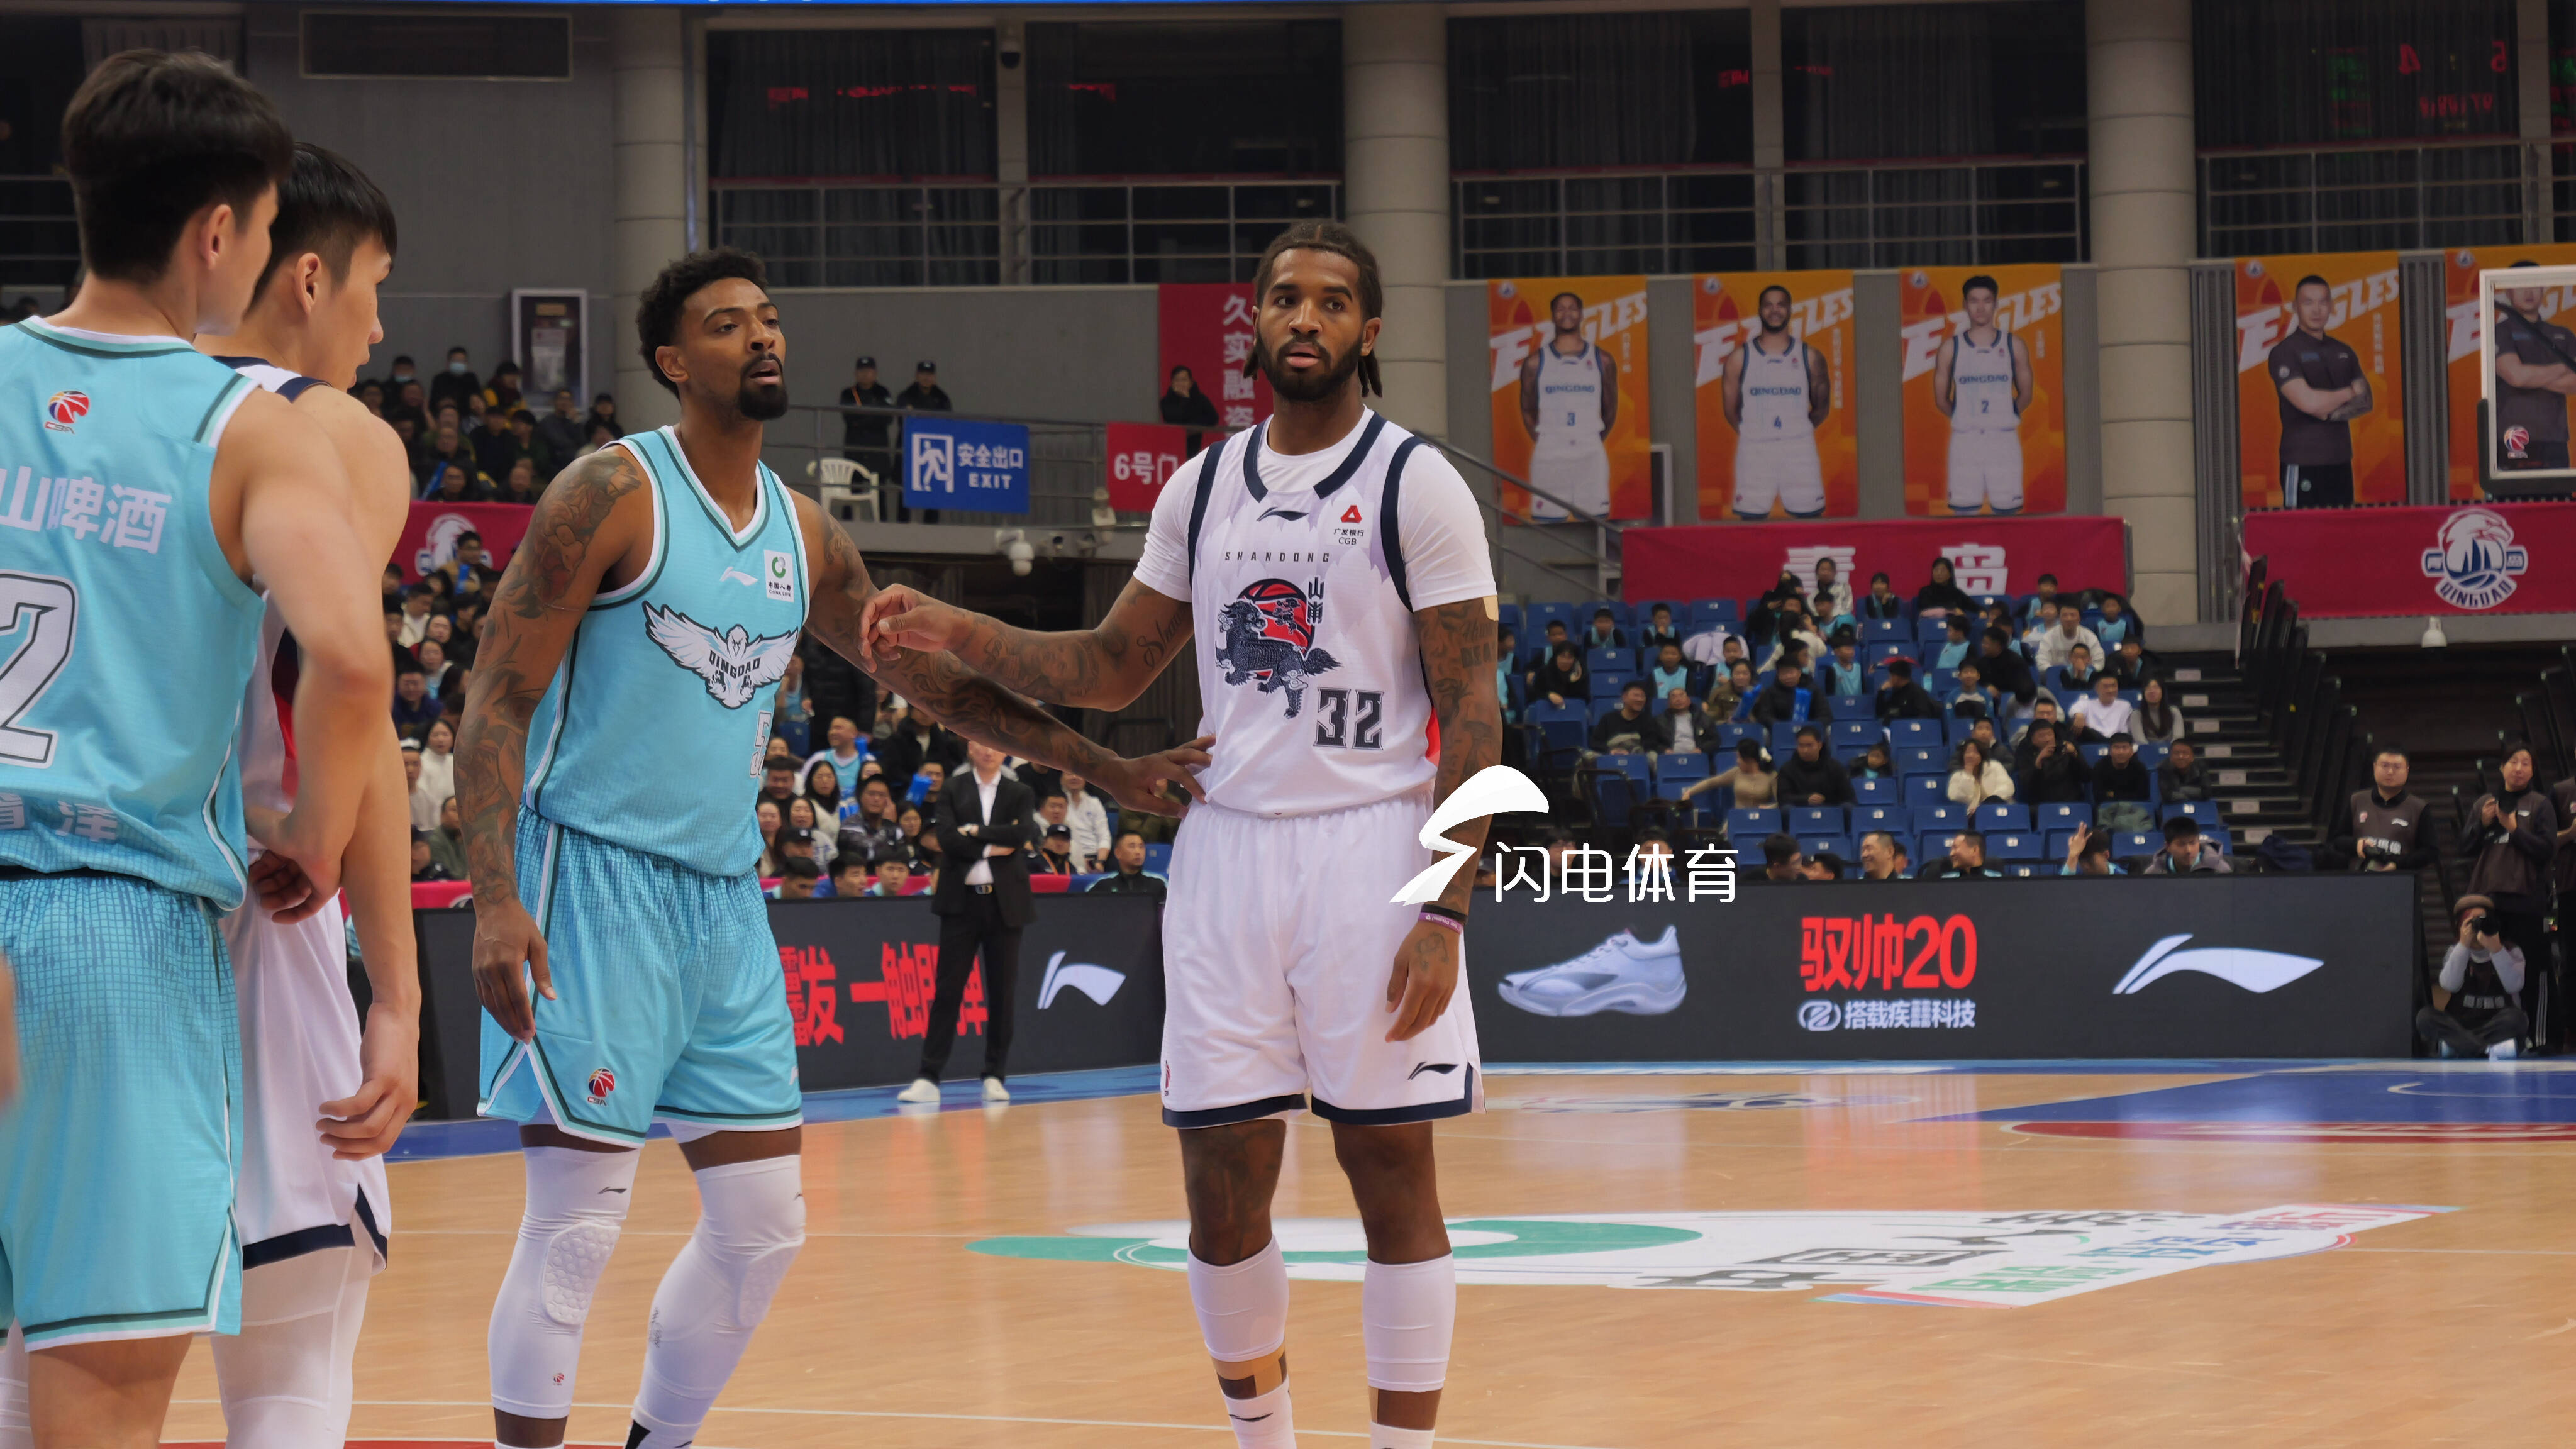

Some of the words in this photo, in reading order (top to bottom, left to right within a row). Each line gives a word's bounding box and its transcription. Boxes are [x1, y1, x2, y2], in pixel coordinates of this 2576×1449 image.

[1981, 399, 1989, 414] 2
[957, 443, 1023, 470] 安全出口
[1114, 453, 1178, 485] 6号门
[969, 473, 1013, 489] EXIT
[1334, 528, 1364, 537] 广发银行
[1338, 536, 1357, 545] CGB
[1224, 551, 1330, 563] SHANDONG
[2440, 580, 2512, 607] QINGDAO
[709, 649, 761, 679] QINGDAO
[1313, 687, 1384, 750] 32
[1800, 913, 1978, 992] 驭帅20
